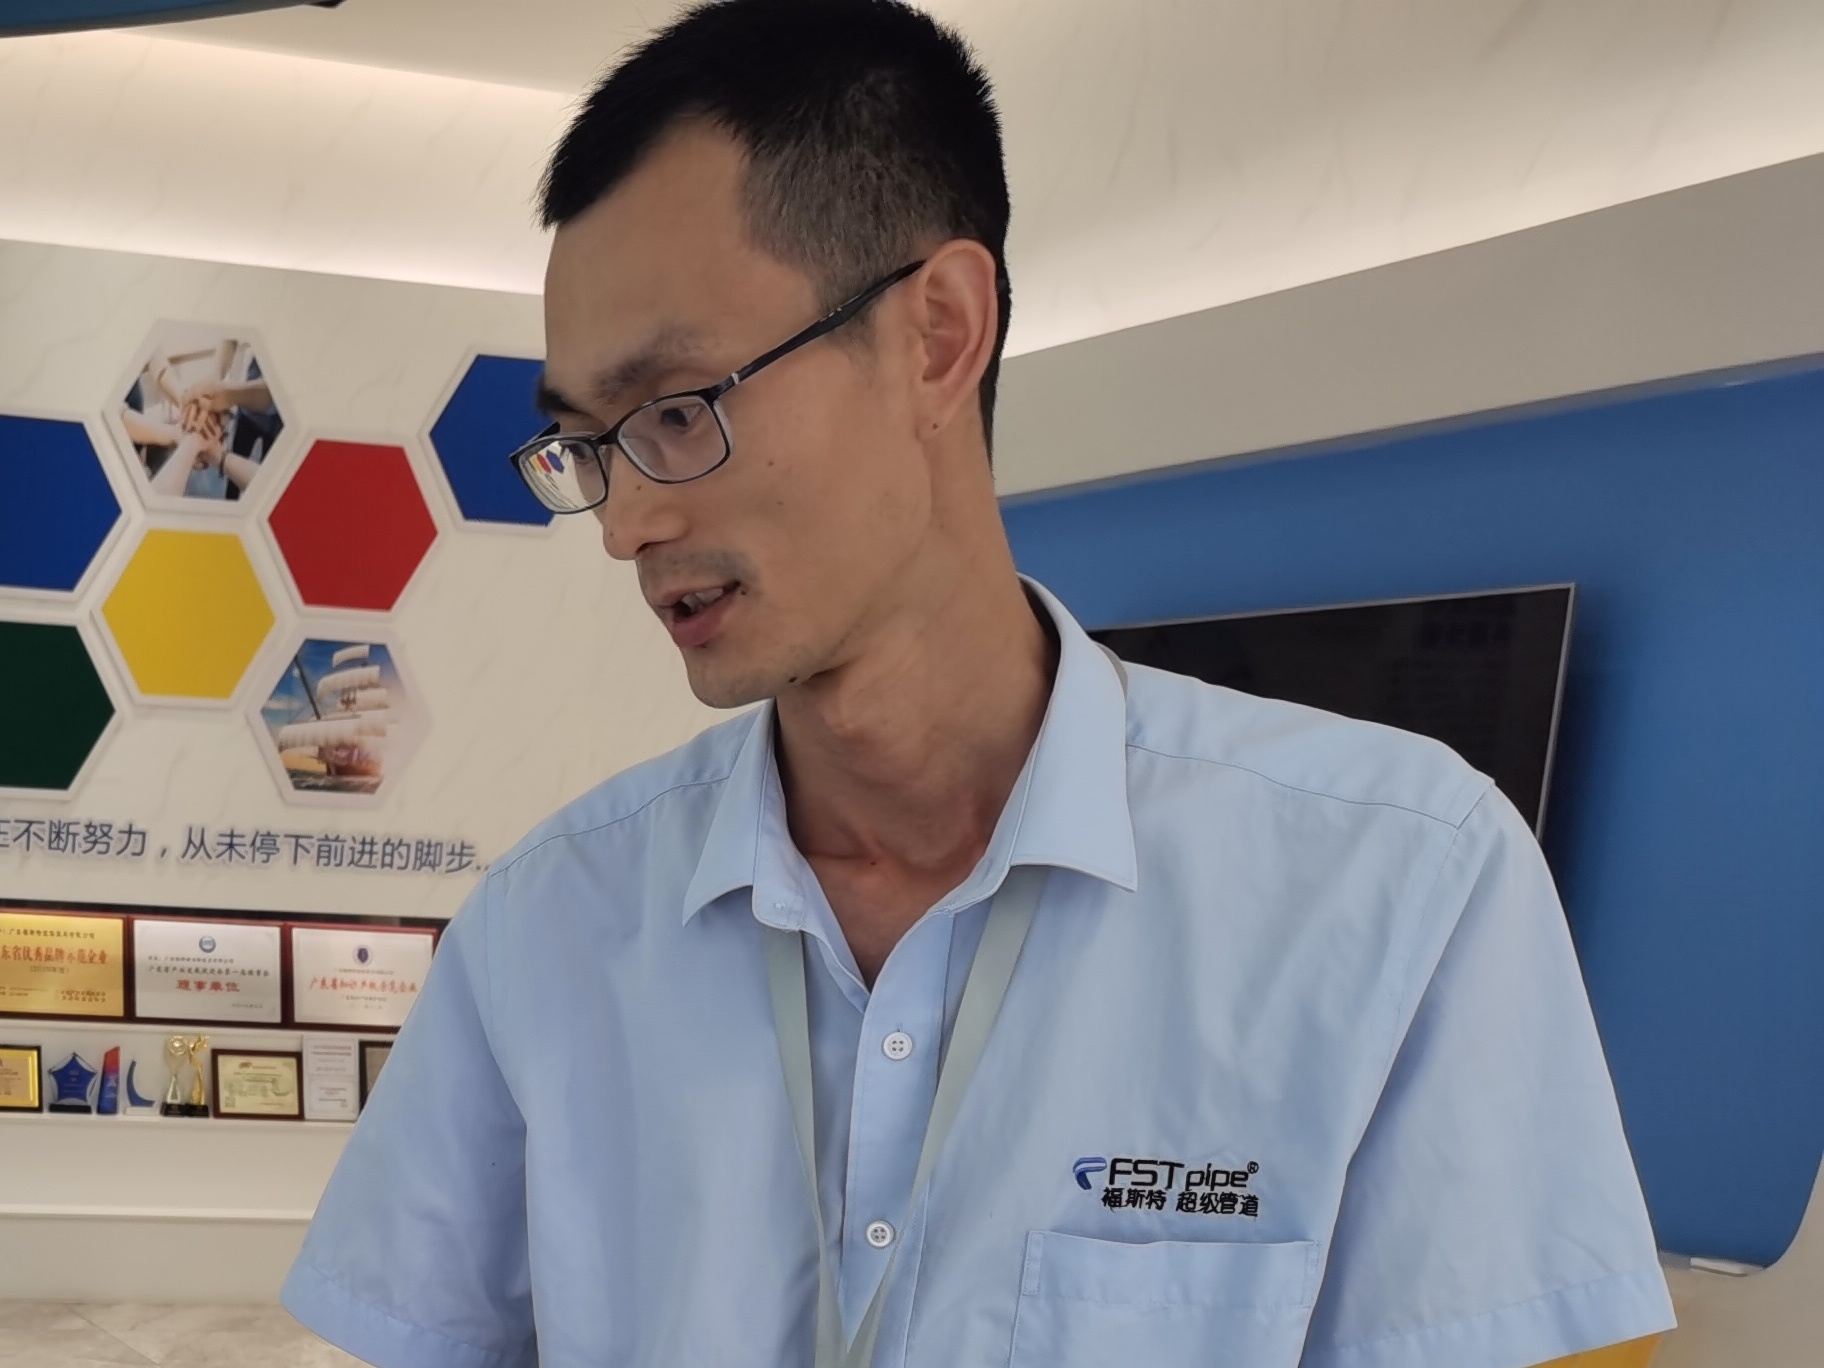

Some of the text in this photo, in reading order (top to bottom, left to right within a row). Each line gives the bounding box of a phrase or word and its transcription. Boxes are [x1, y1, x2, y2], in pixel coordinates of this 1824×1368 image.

[1108, 1157, 1186, 1190] FST
[1101, 1186, 1260, 1218] 福斯特 超级管道
